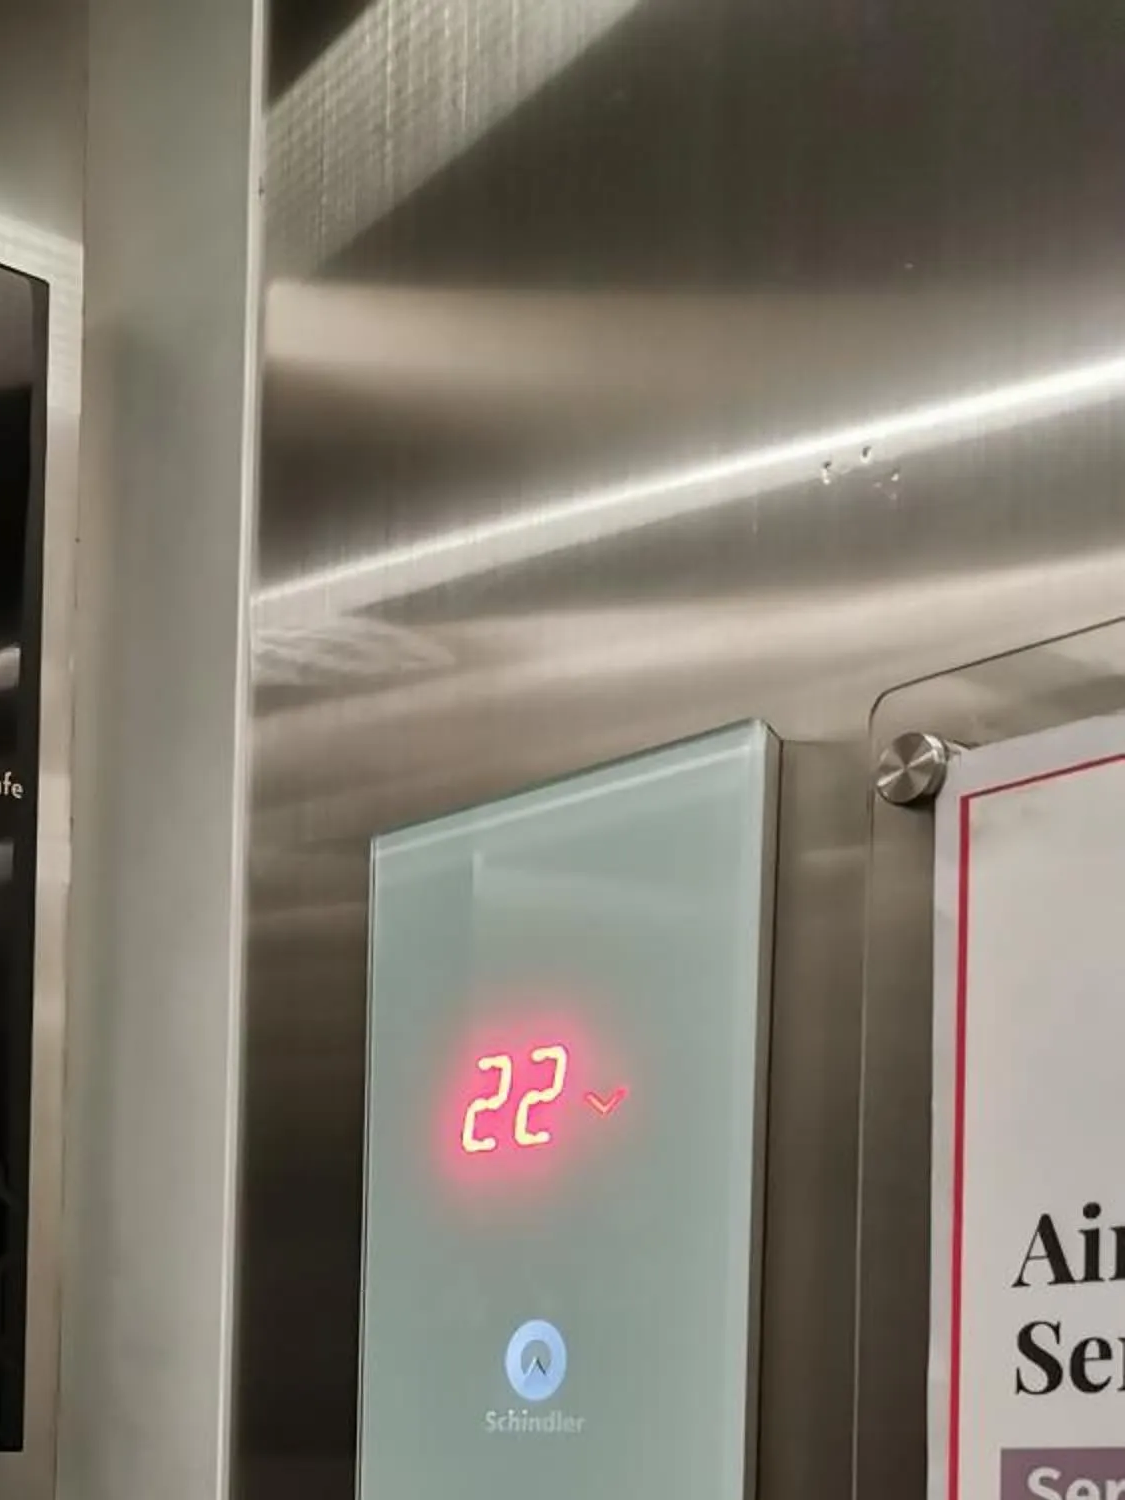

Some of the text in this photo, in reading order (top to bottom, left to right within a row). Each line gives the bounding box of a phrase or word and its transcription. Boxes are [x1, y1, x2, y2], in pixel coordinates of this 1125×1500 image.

[461, 1044, 568, 1153] 22
[1015, 1320, 1125, 1396] Se
[484, 1410, 586, 1435] Schindler
